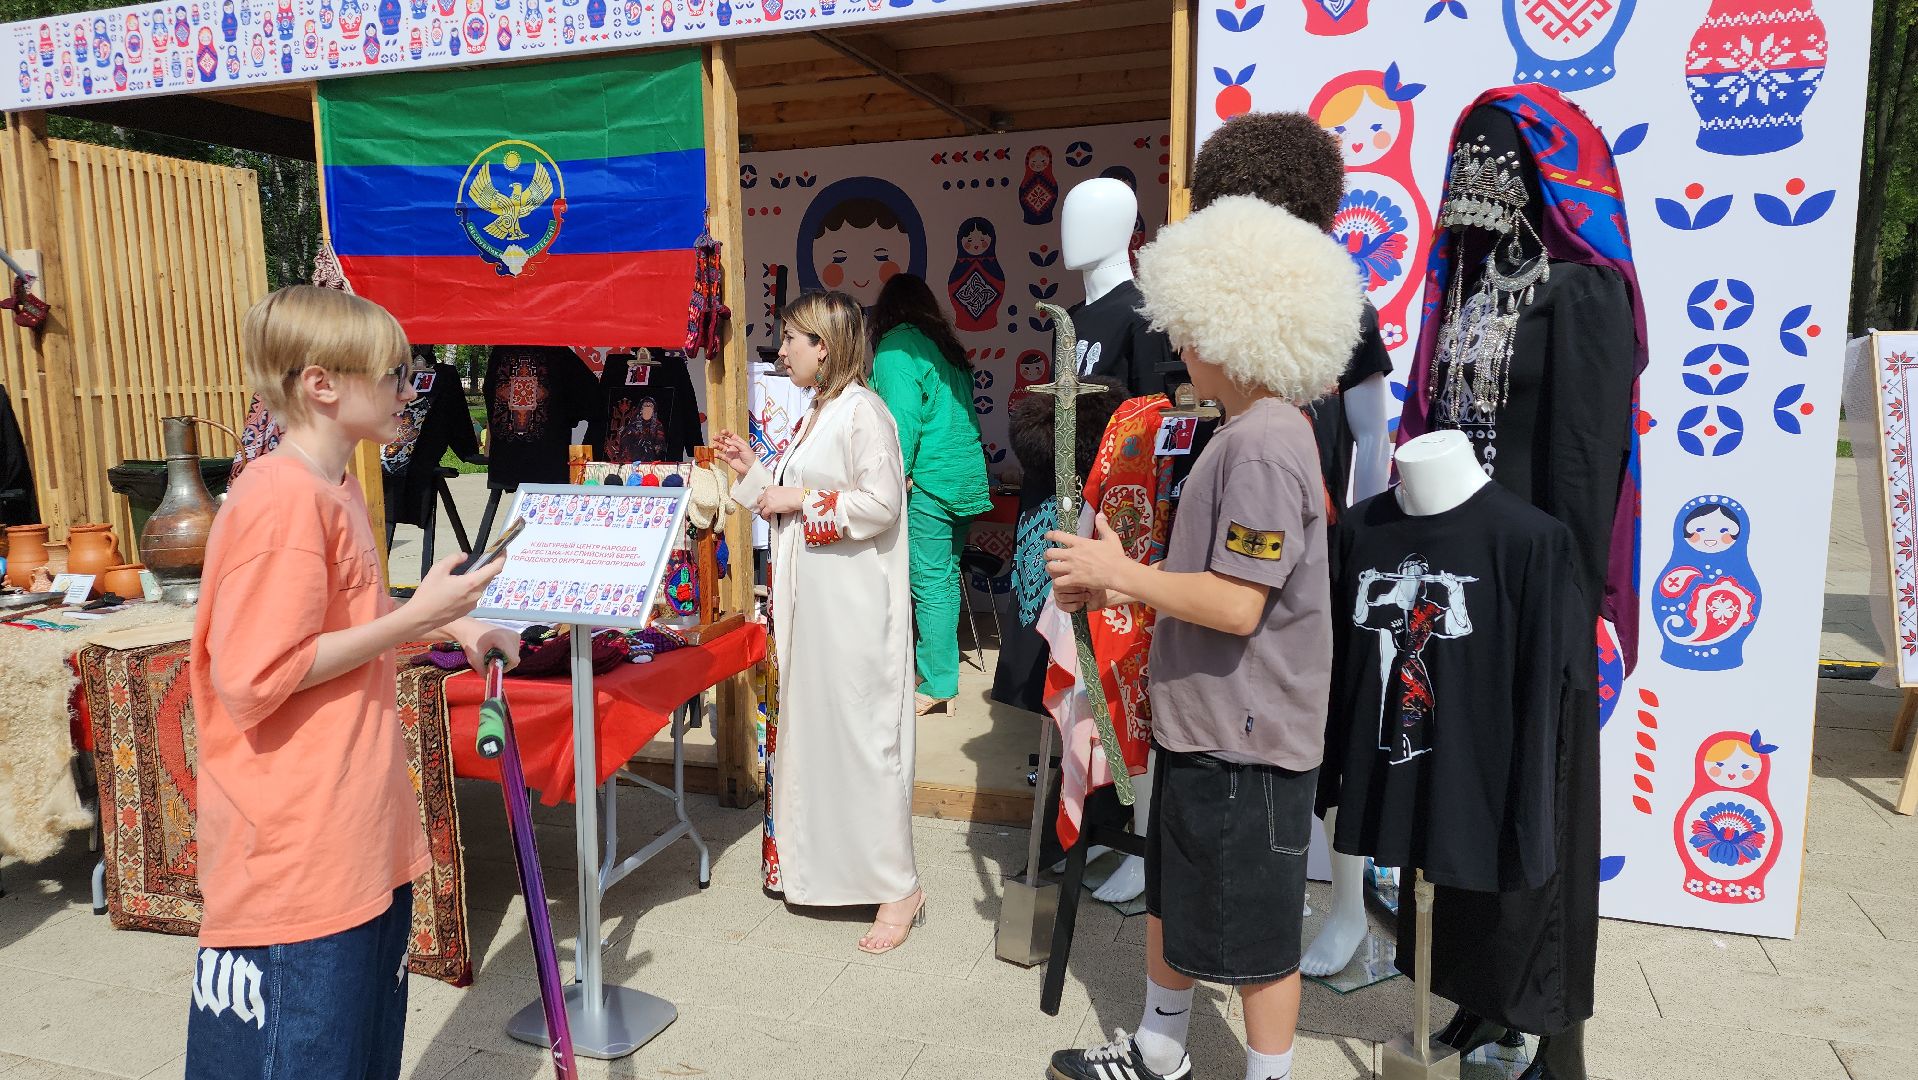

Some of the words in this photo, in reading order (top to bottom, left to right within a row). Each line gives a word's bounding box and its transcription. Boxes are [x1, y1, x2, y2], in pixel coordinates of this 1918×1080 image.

[529, 225, 555, 256] ДАГЕСТАН
[601, 544, 637, 552] НАРОДОВ
[510, 554, 557, 563] ГОРОДСКОГО
[585, 559, 646, 567] ДОЛГОПРУДНЫЙ
